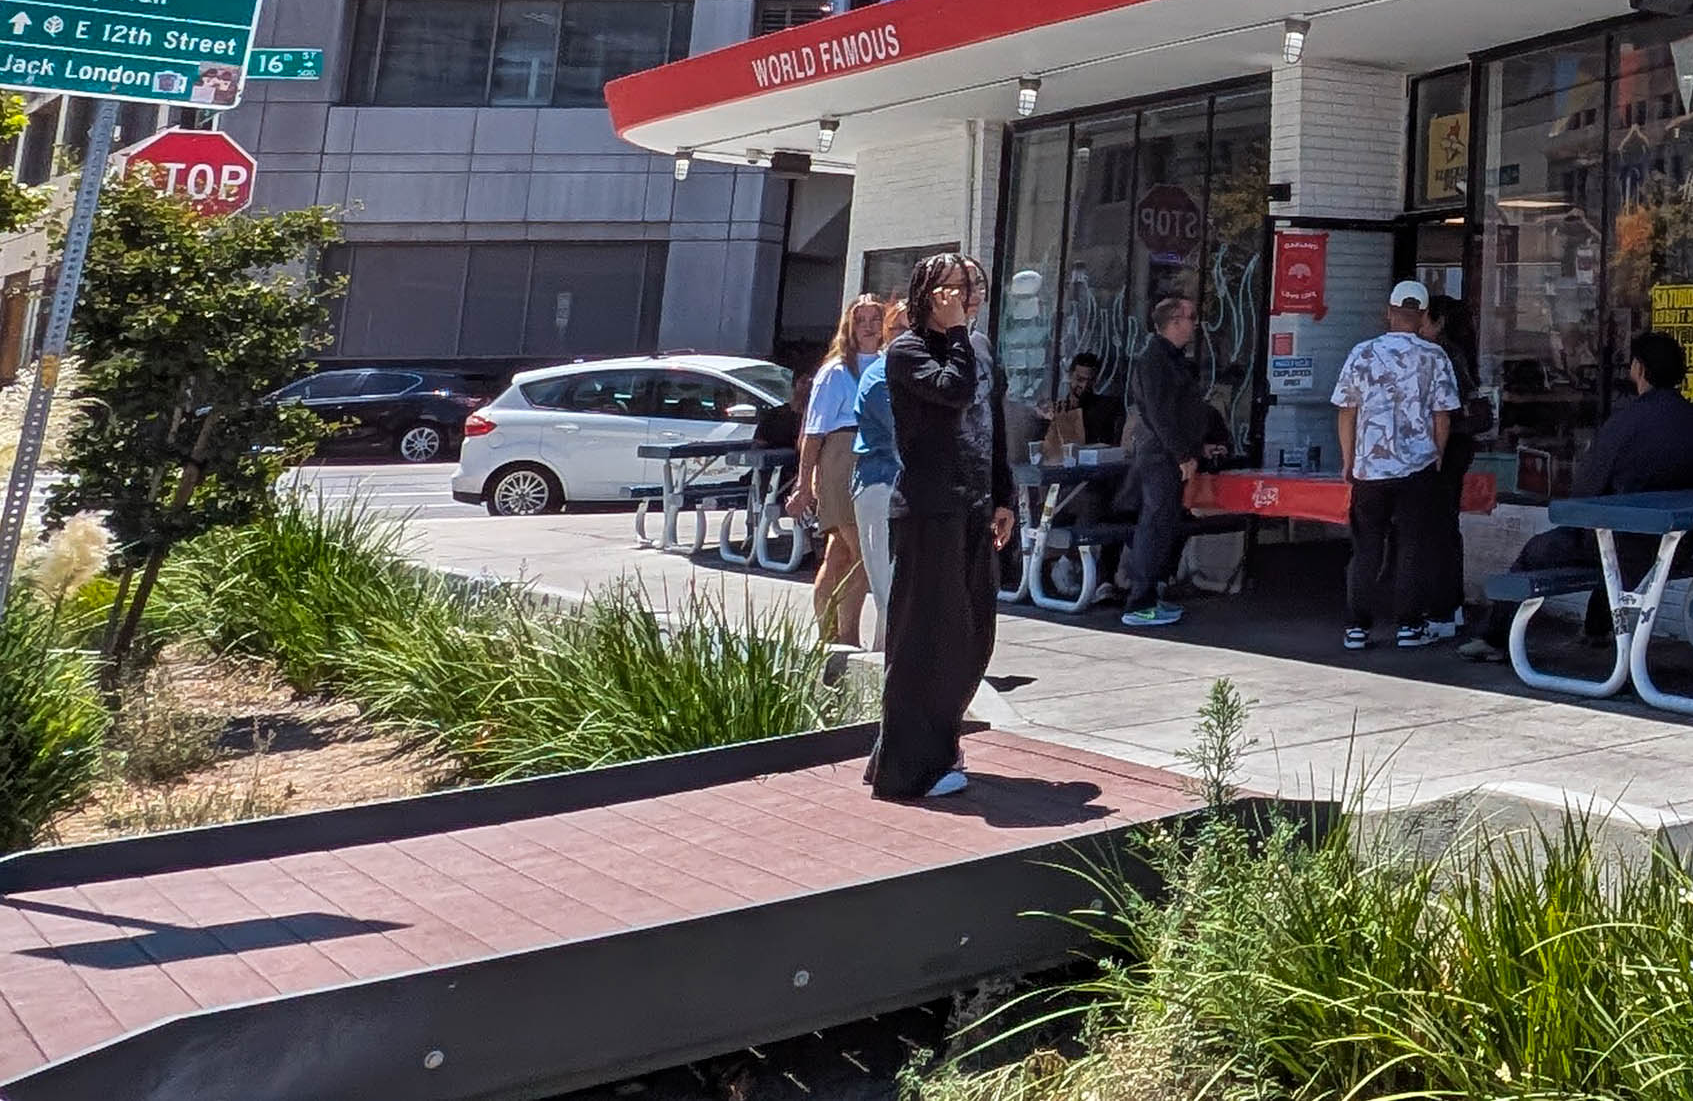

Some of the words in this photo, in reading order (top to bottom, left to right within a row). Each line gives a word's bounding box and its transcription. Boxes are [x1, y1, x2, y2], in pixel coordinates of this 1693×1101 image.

[75, 21, 91, 39] E
[103, 24, 152, 46] 12th
[163, 30, 236, 55] Street
[751, 47, 815, 87] WORLD
[819, 24, 900, 73] FAMOUS
[0, 54, 55, 76] Jack
[65, 60, 150, 86] London
[150, 162, 248, 200] TOP
